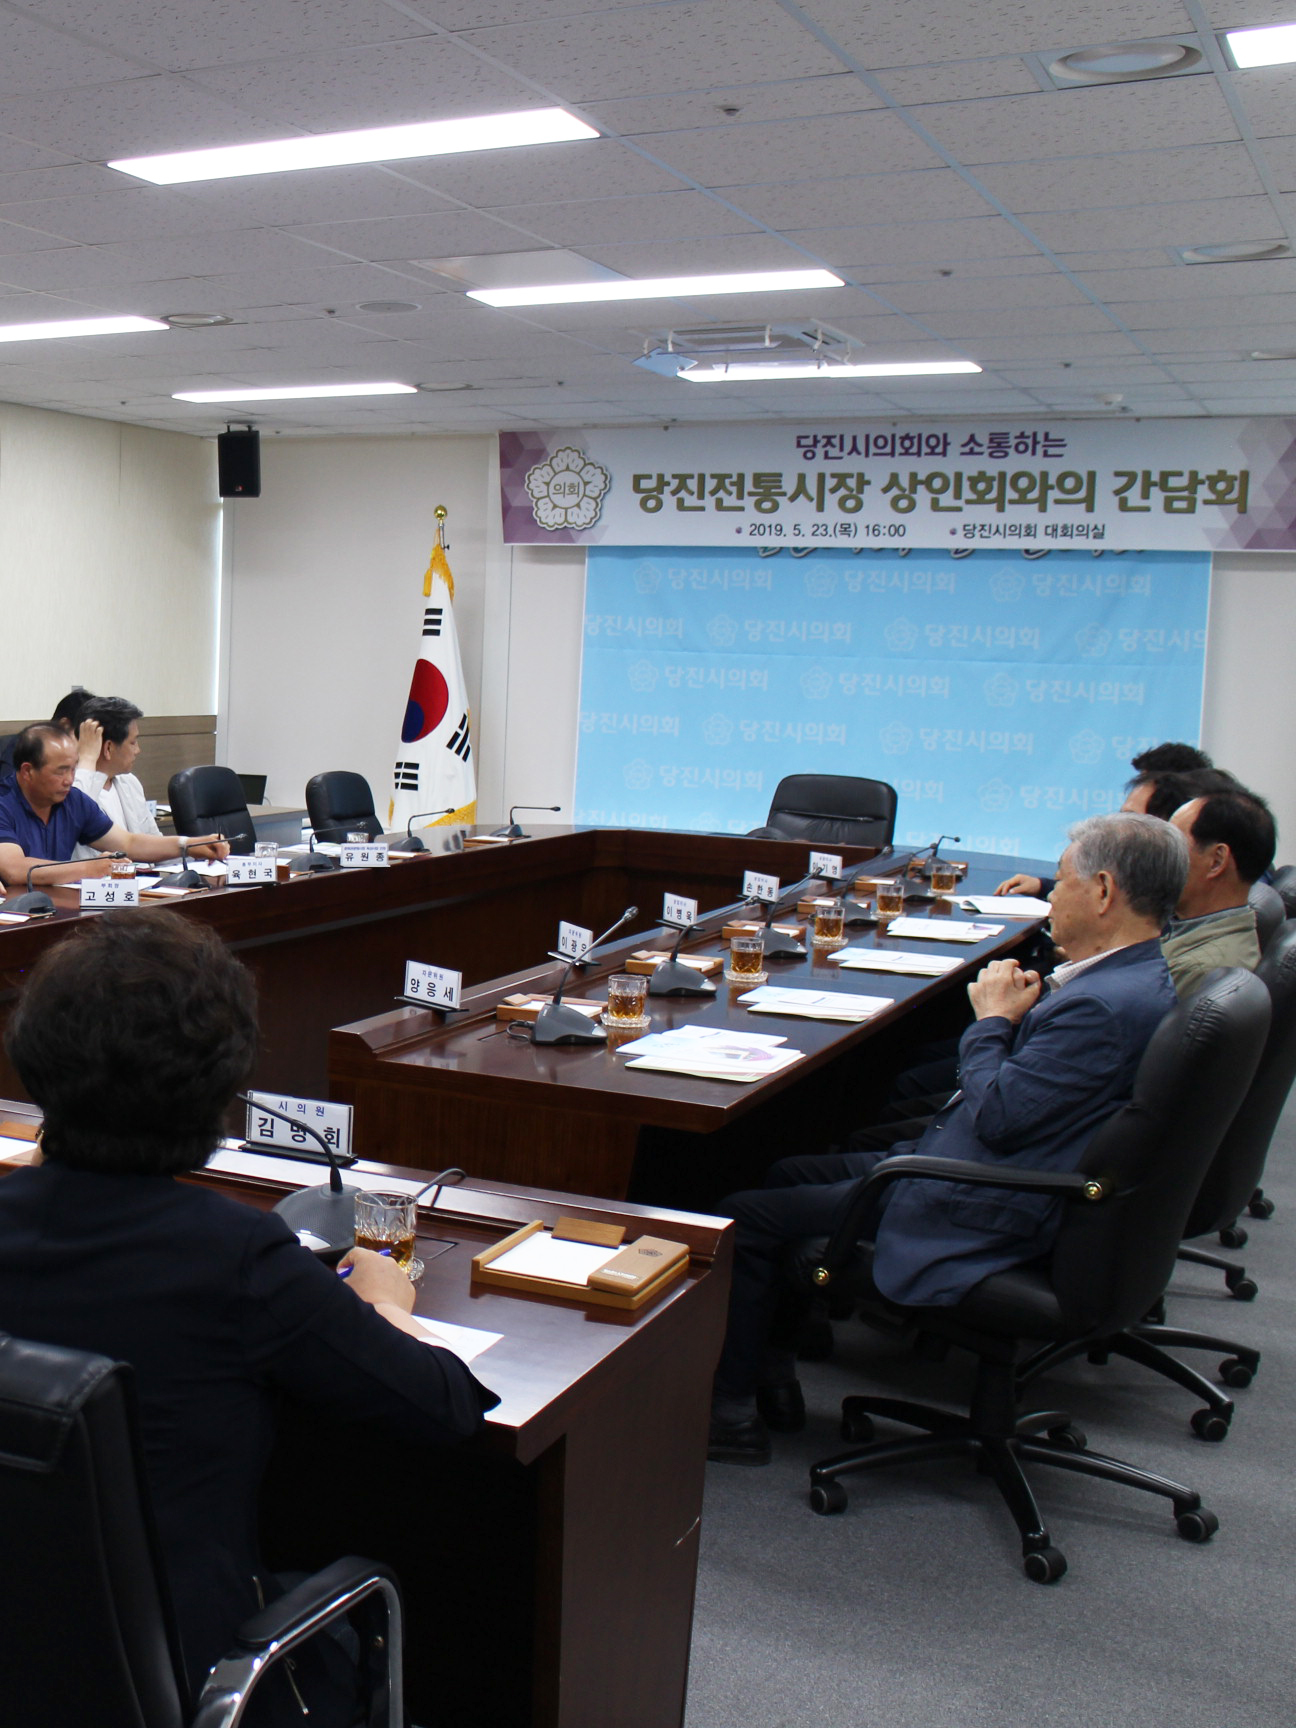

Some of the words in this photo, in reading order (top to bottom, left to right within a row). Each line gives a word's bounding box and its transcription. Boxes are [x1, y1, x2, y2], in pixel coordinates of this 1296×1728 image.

[796, 432, 951, 461] 당진시의회와
[960, 431, 1067, 459] 소통하는
[552, 481, 581, 499] 의회
[631, 471, 871, 514] 당진전통시장
[881, 469, 1097, 514] 상인회와의
[1112, 468, 1251, 514] 간담회
[748, 523, 788, 538] 2019.
[792, 524, 806, 538] 5.
[811, 523, 859, 539] 23.(목)
[864, 523, 907, 538] 16:00
[961, 523, 1037, 540] 당진시의회
[1044, 523, 1106, 540] 대회의실
[667, 567, 773, 591] 당진시의회
[843, 569, 956, 595] 당진시의회
[1031, 572, 1152, 597] 당진시의회
[743, 618, 853, 644] 당진시의회
[924, 624, 1041, 649] 당진시의회
[664, 664, 769, 692] 당진시의회
[838, 672, 951, 699] 당진시의회
[1025, 679, 1146, 706] 당진시의회
[738, 718, 848, 746] 당진시의회
[919, 727, 1035, 756] 당진시의회
[659, 763, 765, 793] 당진시의회
[1019, 784, 1127, 813] 당진시의
[85, 891, 135, 902] 고성호
[410, 978, 454, 1003] 양응세
[278, 1101, 325, 1117] 시의원
